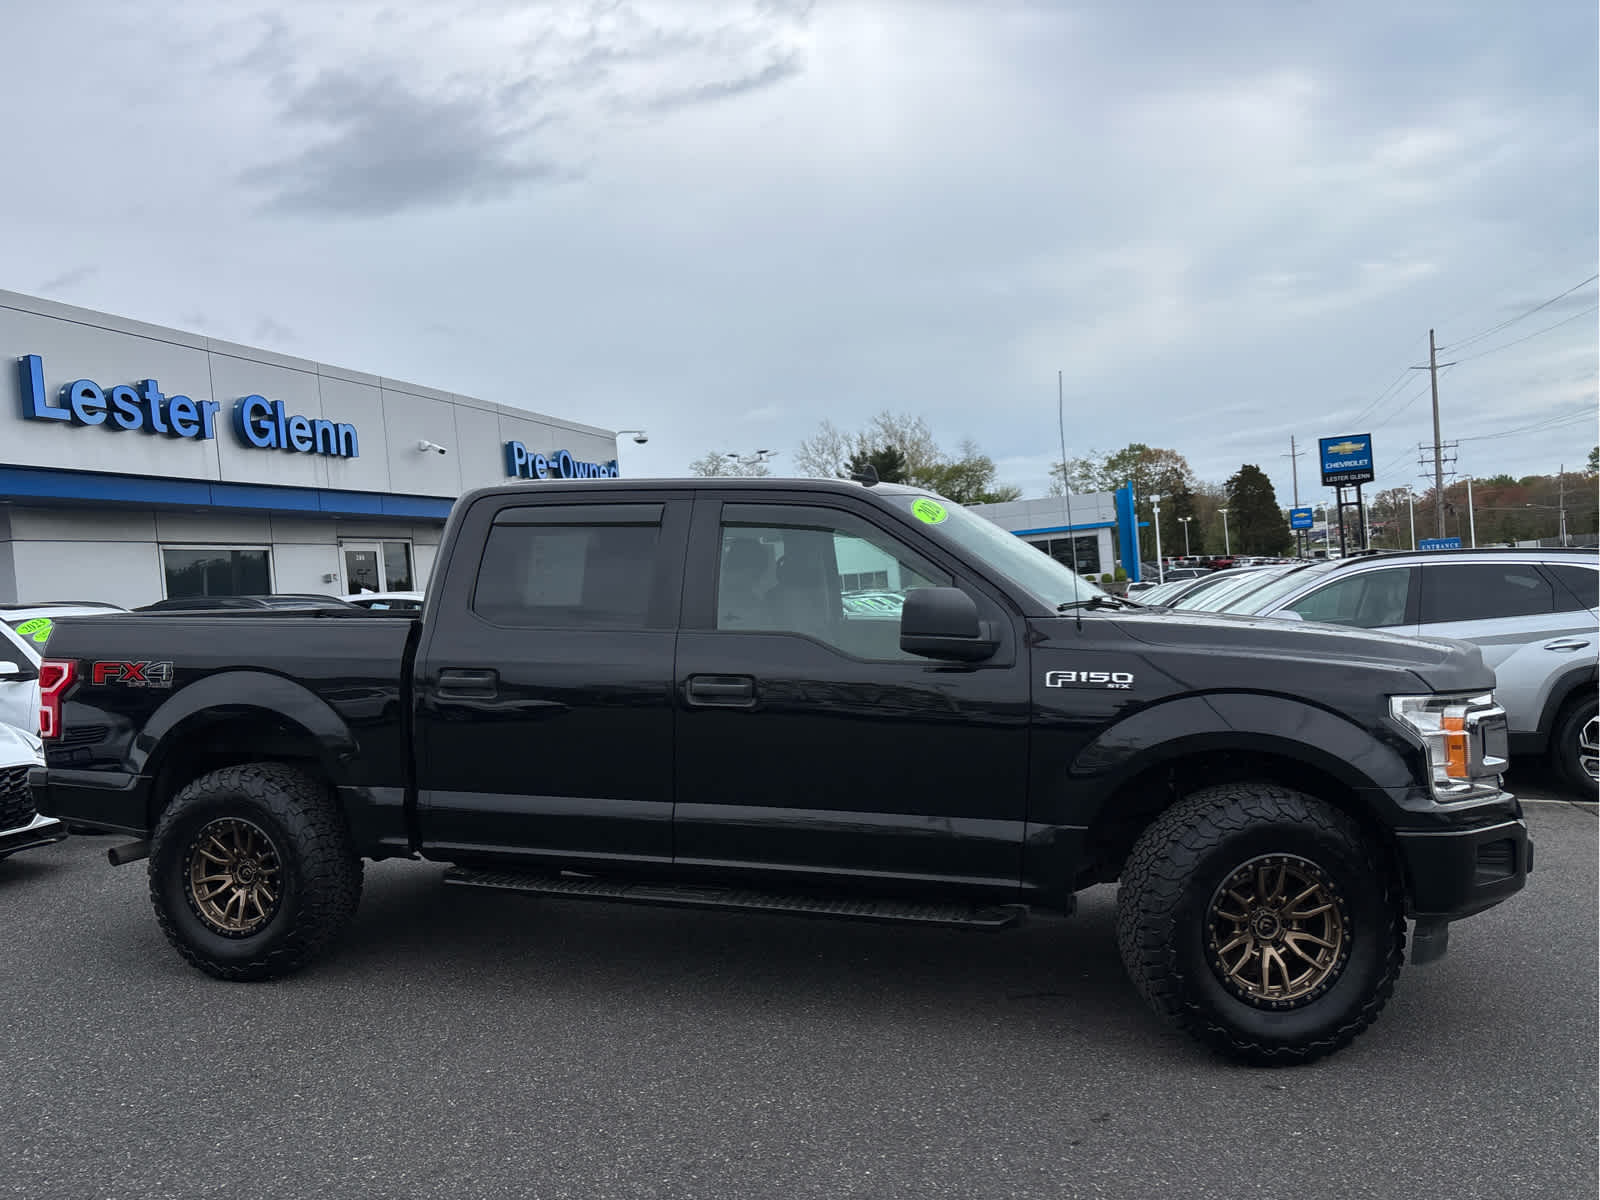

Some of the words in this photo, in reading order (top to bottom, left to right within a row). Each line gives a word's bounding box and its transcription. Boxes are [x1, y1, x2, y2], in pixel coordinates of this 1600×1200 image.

[17, 354, 220, 440] Lester
[234, 394, 360, 457] Glenn
[505, 440, 619, 479] Pre-Owned
[1325, 459, 1368, 469] CHEVROLET
[1421, 542, 1460, 550] ENTRANCE
[92, 660, 174, 686] FX4
